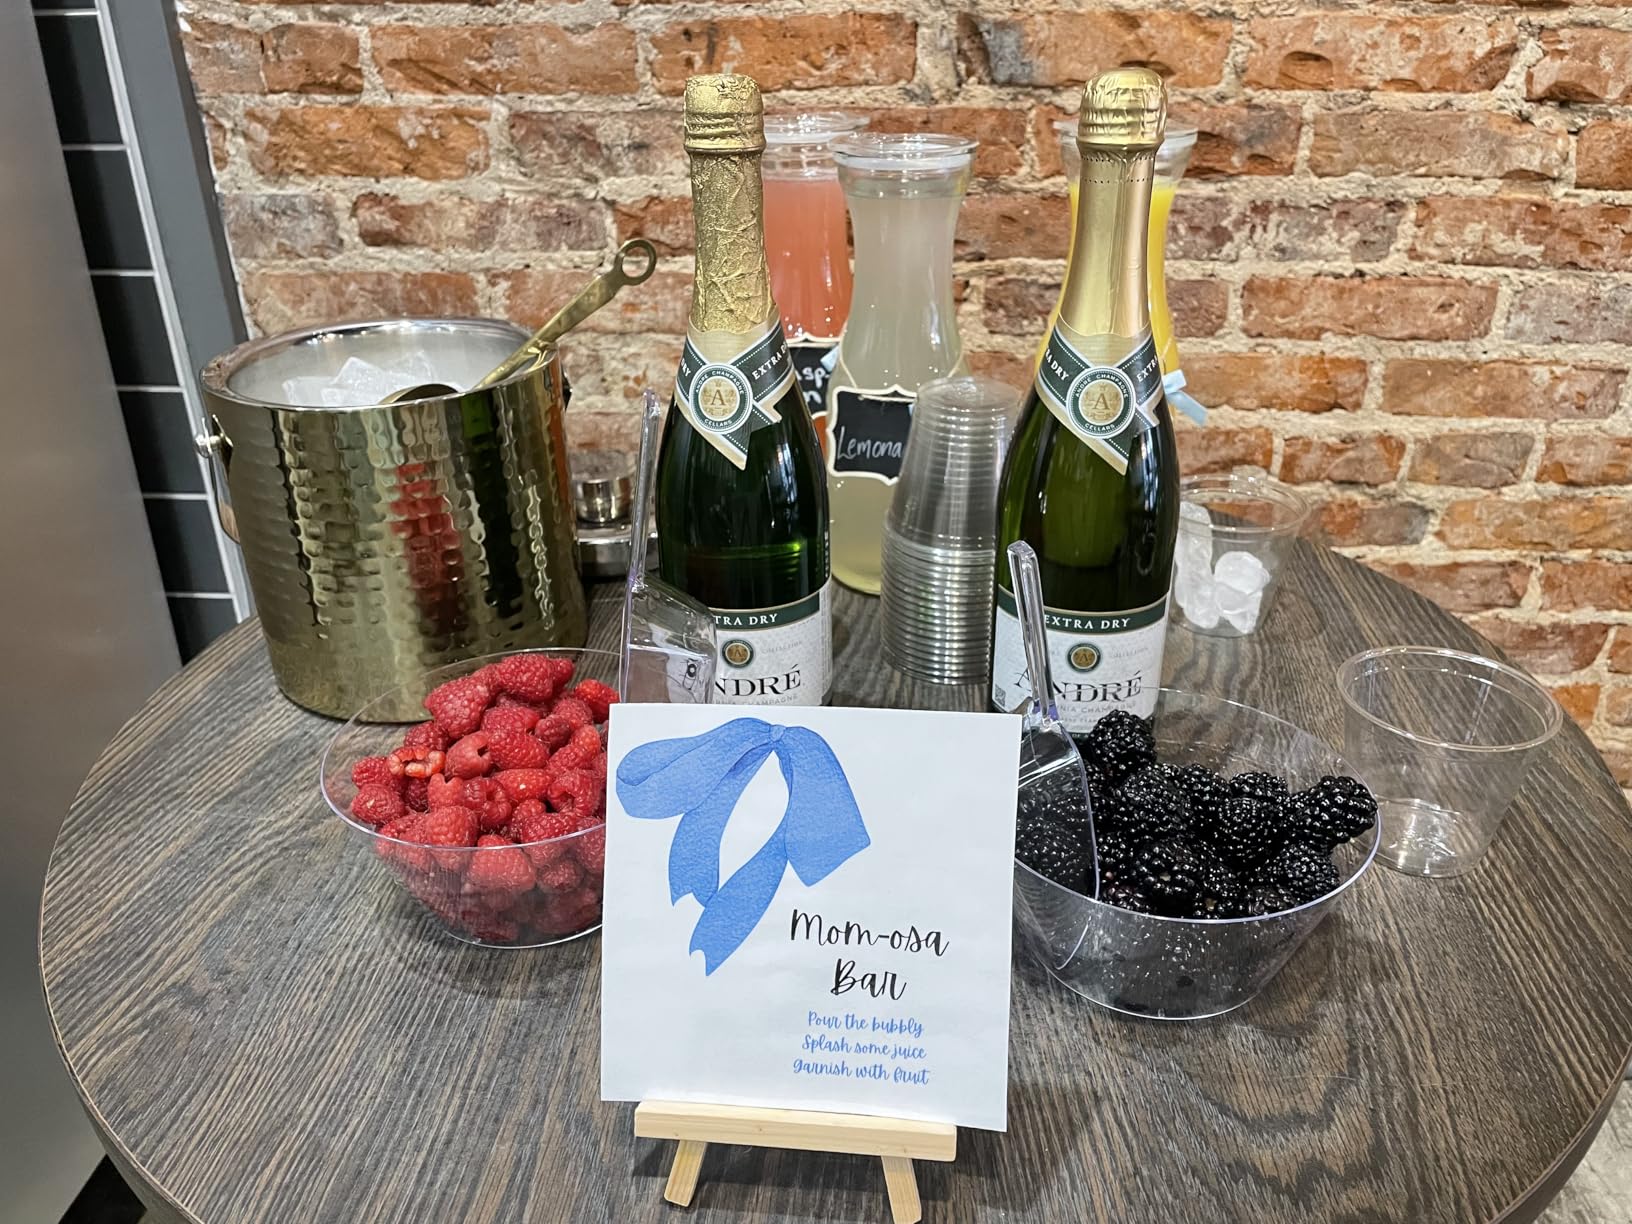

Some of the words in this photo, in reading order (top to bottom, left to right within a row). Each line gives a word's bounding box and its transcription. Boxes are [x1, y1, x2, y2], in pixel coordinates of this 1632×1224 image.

[752, 352, 782, 380] EXTRA
[1050, 360, 1069, 381] DRY
[711, 370, 745, 395] CHAMPAGNE
[1096, 373, 1129, 399] CHAMPAGNE
[710, 389, 726, 405] A
[1092, 393, 1110, 410] A
[704, 418, 732, 427] CELLARS
[1084, 423, 1115, 431] CELLARS
[837, 425, 903, 460] Lemona
[714, 614, 742, 626] TRA
[749, 612, 778, 625] DRY
[1045, 616, 1094, 629] EXTRA
[1100, 617, 1131, 630] DRY
[715, 663, 801, 697] NDRÉ
[791, 909, 950, 957] Mom-osa
[830, 958, 907, 1001] Bar
[808, 1010, 841, 1030] Pour
[844, 1013, 868, 1031] the
[871, 1016, 924, 1038] bubbly
[802, 1034, 852, 1054] Splash
[853, 1042, 891, 1056] some
[890, 1045, 927, 1060] juice
[855, 1063, 890, 1081] with
[893, 1066, 931, 1086] fruit
